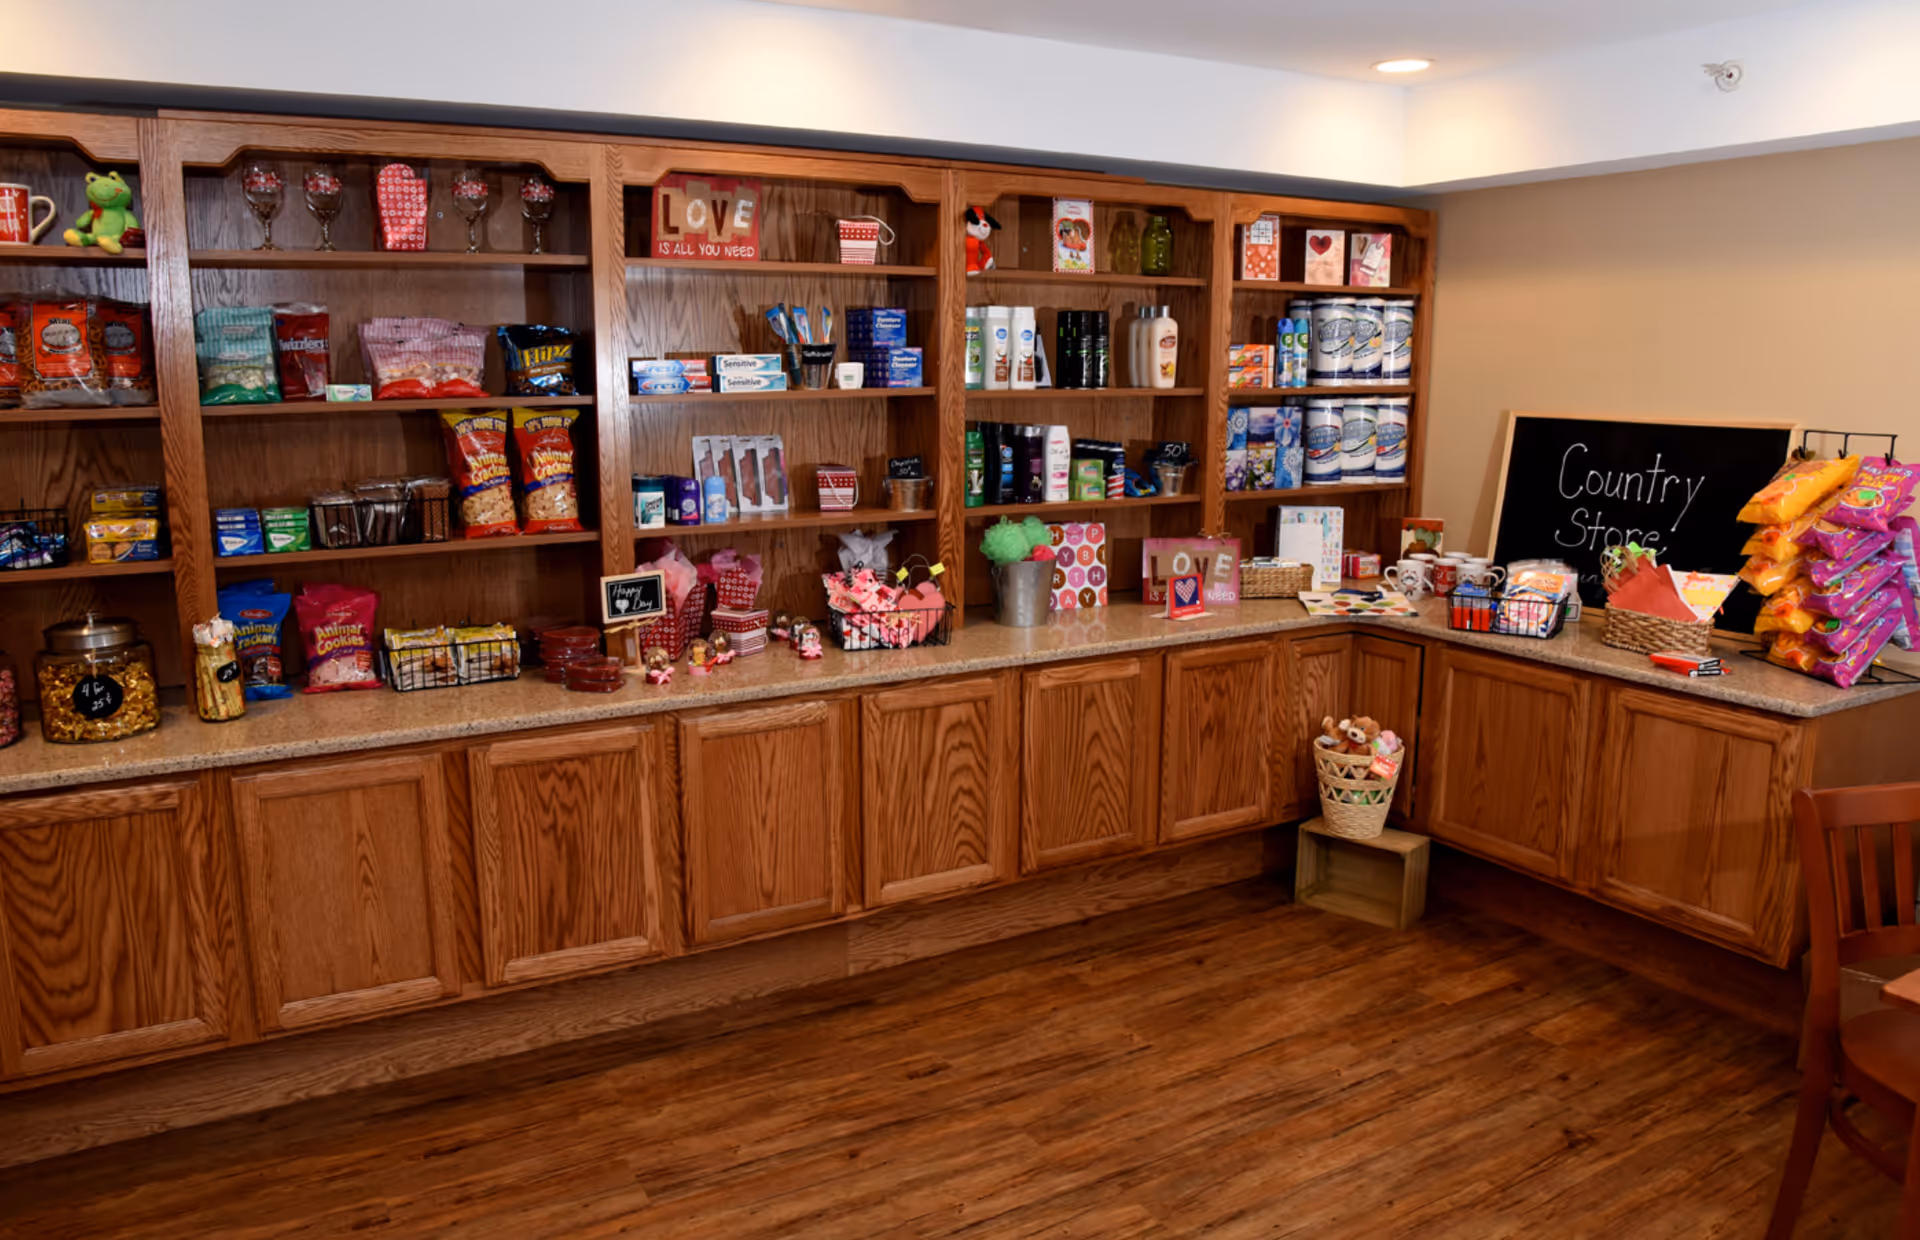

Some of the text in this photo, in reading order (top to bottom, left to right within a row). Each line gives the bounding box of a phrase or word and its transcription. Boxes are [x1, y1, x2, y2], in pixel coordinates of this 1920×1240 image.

[662, 194, 753, 237] LOVE
[658, 242, 755, 258] IS ALL YOU NEED
[723, 360, 758, 369] Sensitive
[727, 378, 763, 387] Sensitive
[1558, 442, 1705, 532] Country
[1554, 507, 1668, 556] Store
[1150, 552, 1233, 587] LOVE
[612, 584, 643, 599] Happy
[1207, 592, 1236, 602] NEED
[632, 597, 653, 611] Day
[315, 621, 363, 641] Animal
[316, 634, 364, 656] Cookies
